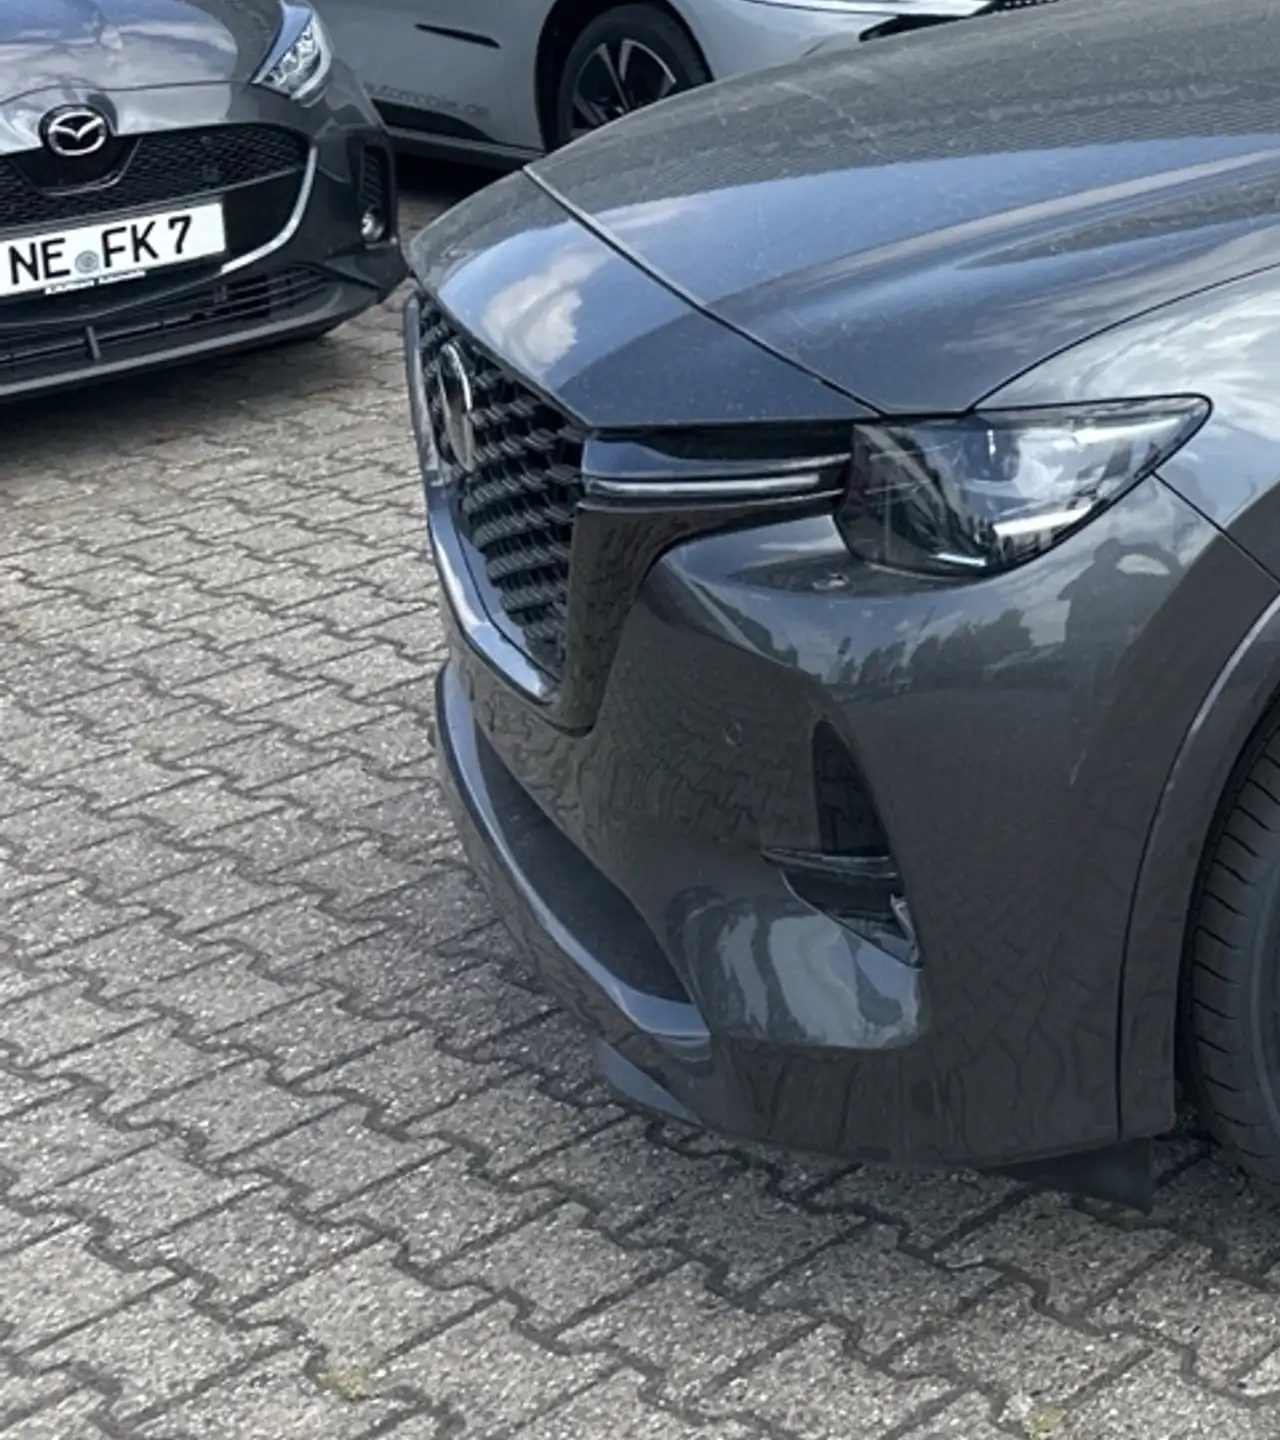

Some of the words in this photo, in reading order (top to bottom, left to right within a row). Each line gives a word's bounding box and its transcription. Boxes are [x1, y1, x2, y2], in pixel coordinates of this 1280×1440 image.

[9, 238, 71, 285] NE
[101, 221, 158, 268] FK
[168, 215, 191, 254] 7
